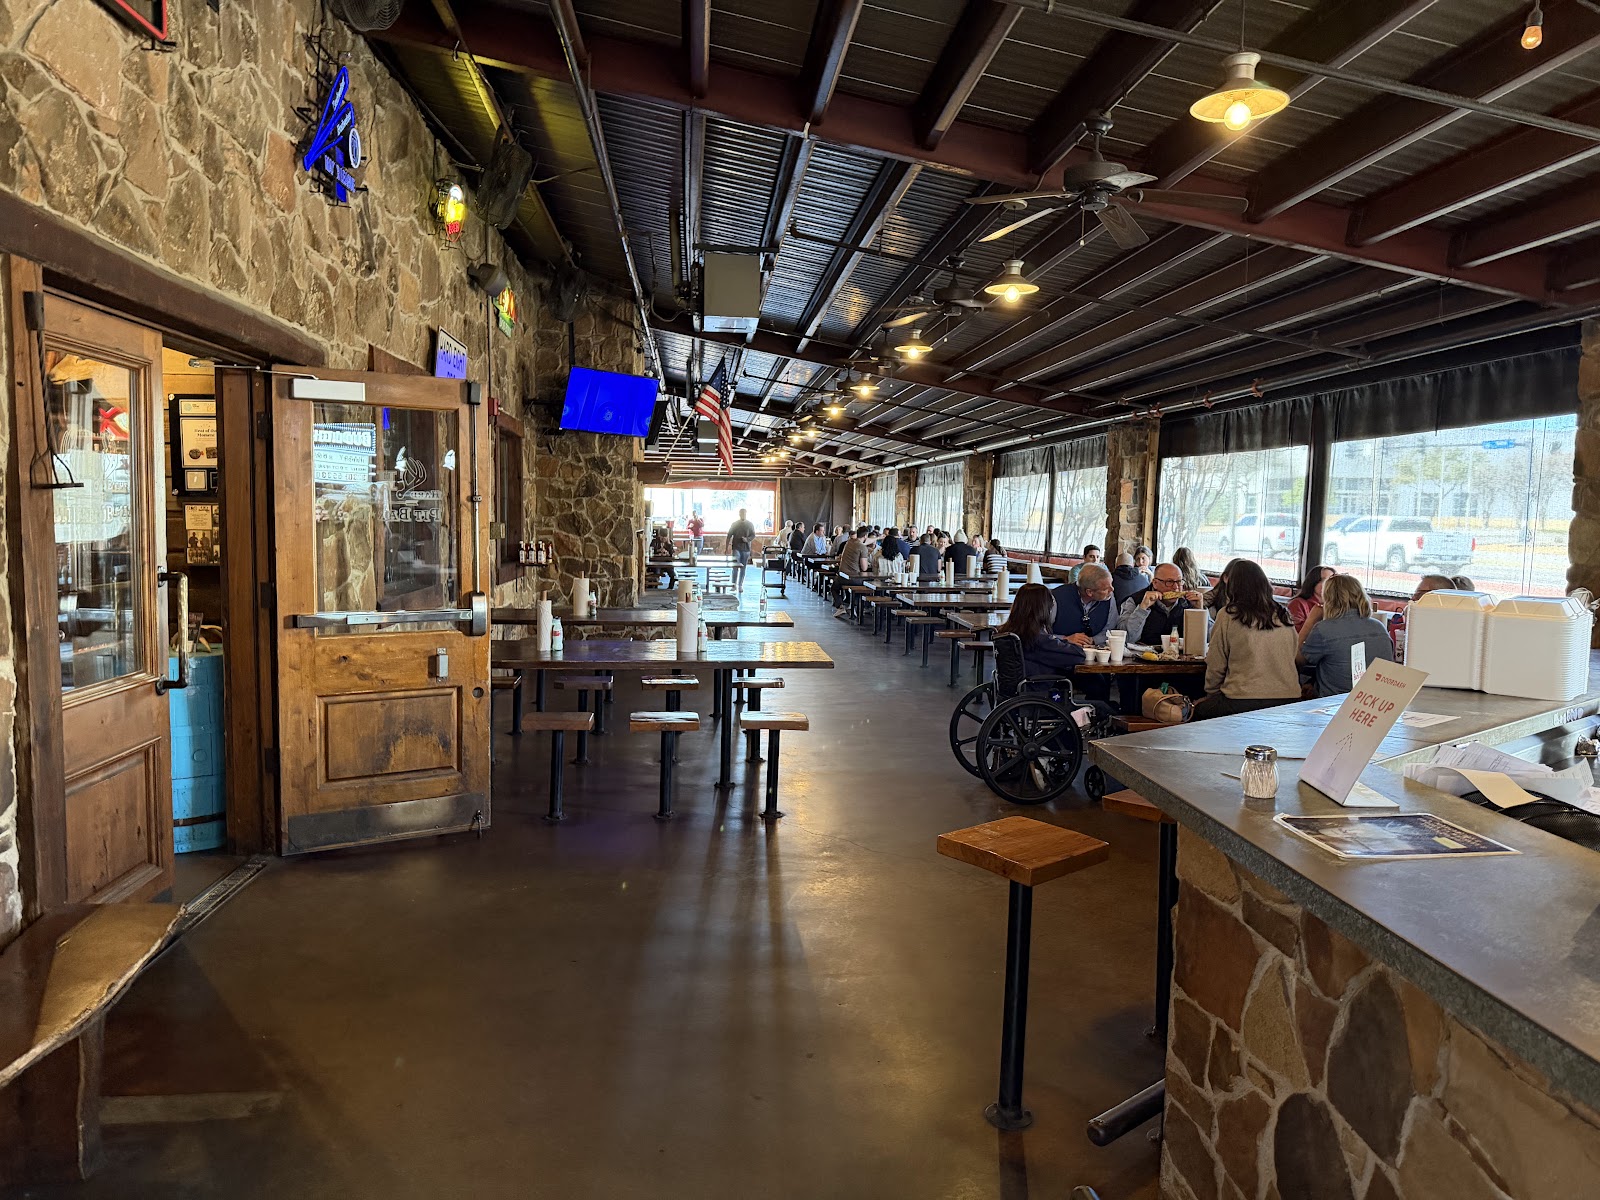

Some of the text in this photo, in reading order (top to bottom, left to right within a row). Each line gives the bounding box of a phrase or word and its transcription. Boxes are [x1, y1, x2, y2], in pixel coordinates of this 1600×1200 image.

[438, 335, 467, 373] HARD EIGHT
[1381, 676, 1407, 689] DOORDASH
[1353, 690, 1395, 714] PICK UP
[1348, 707, 1378, 728] HERE
